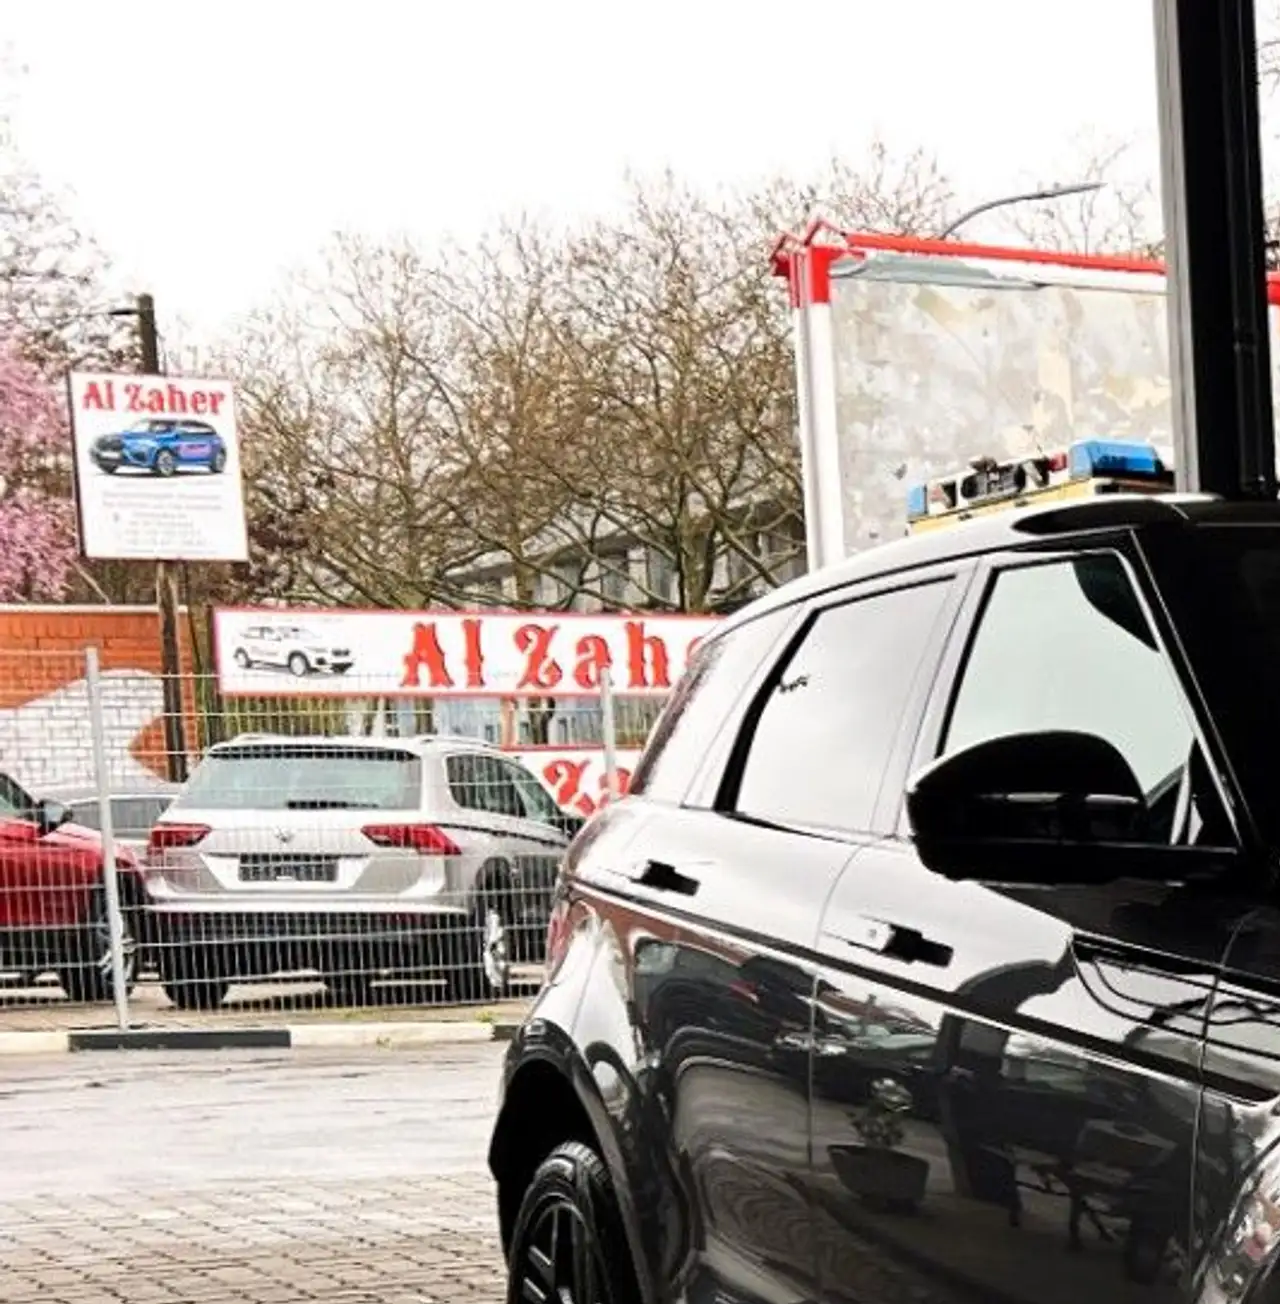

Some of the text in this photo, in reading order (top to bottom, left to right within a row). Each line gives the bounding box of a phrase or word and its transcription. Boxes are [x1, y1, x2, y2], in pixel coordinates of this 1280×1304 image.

[82, 379, 226, 415] Al Zaher
[399, 618, 486, 688] Al
